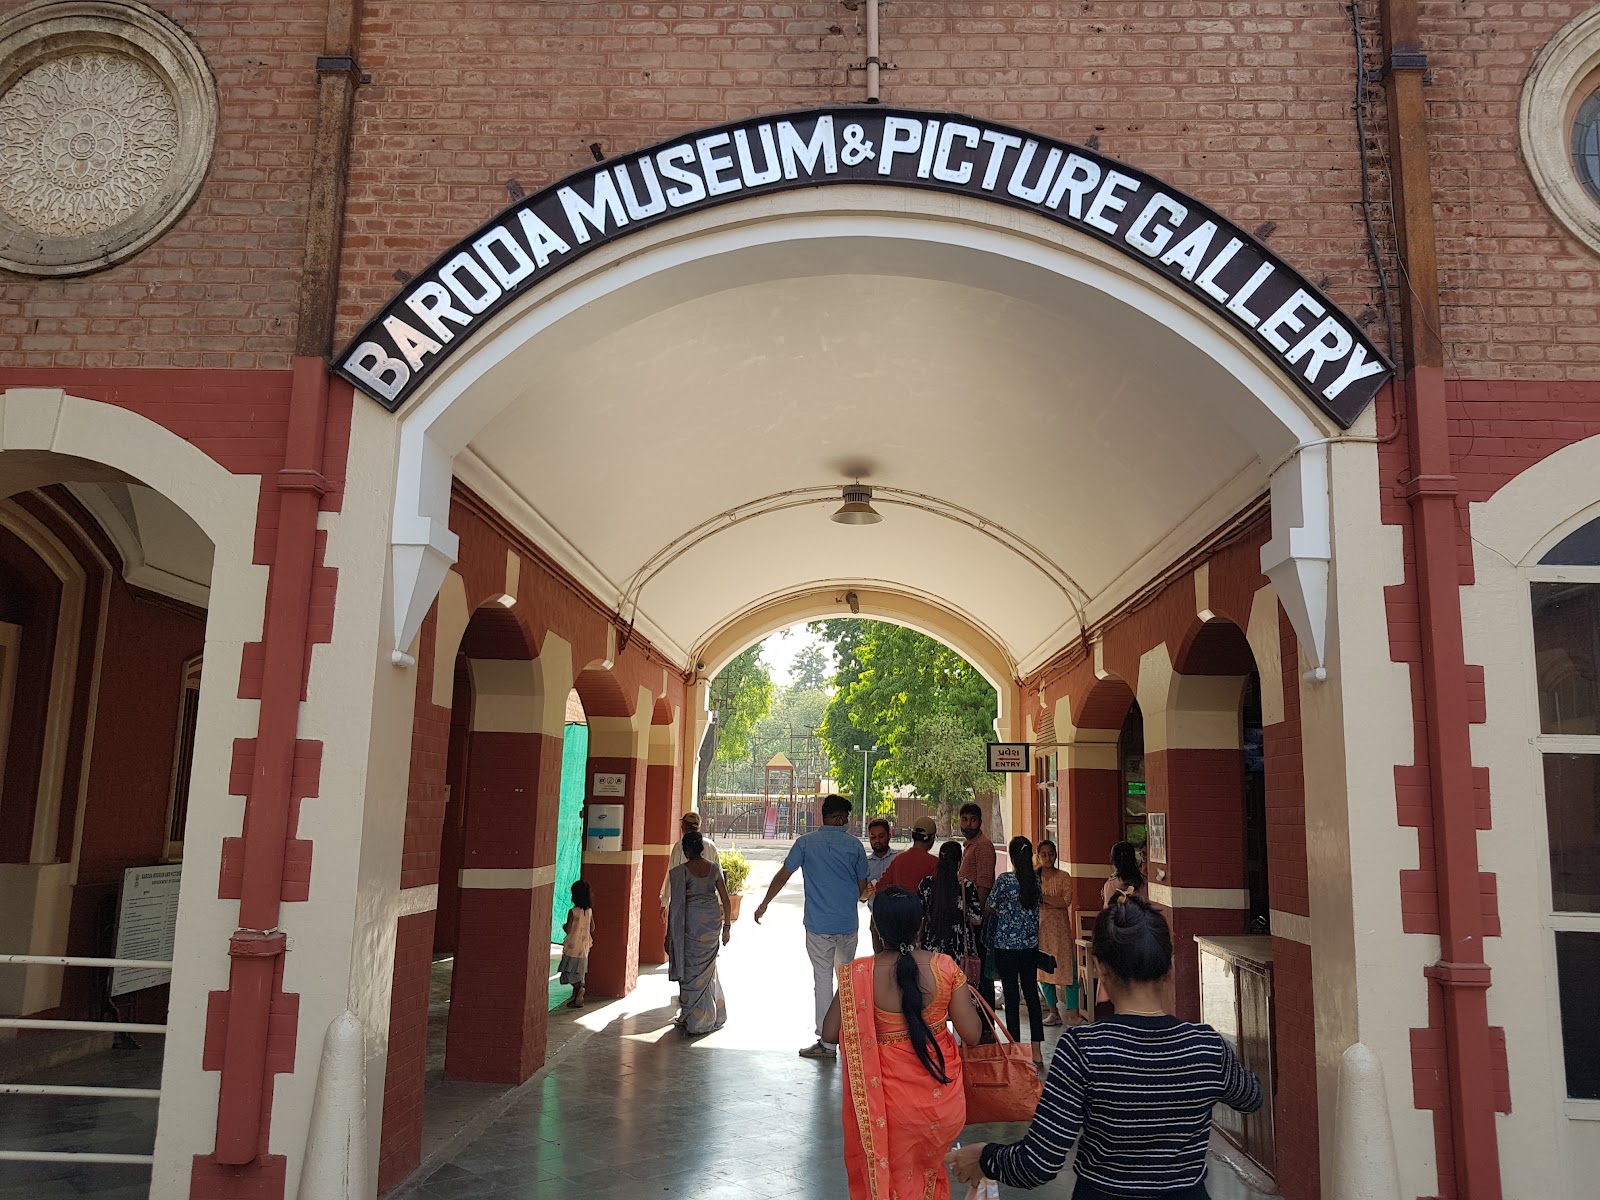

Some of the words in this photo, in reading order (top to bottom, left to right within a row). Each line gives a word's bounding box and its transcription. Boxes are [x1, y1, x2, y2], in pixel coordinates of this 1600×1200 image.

[342, 208, 570, 401] BARODA
[556, 115, 837, 244] MUSEUM
[841, 123, 876, 166] &
[877, 116, 1141, 235] PICTURE
[1124, 192, 1387, 401] GALLERY
[997, 747, 1020, 757] પ્રવેશ
